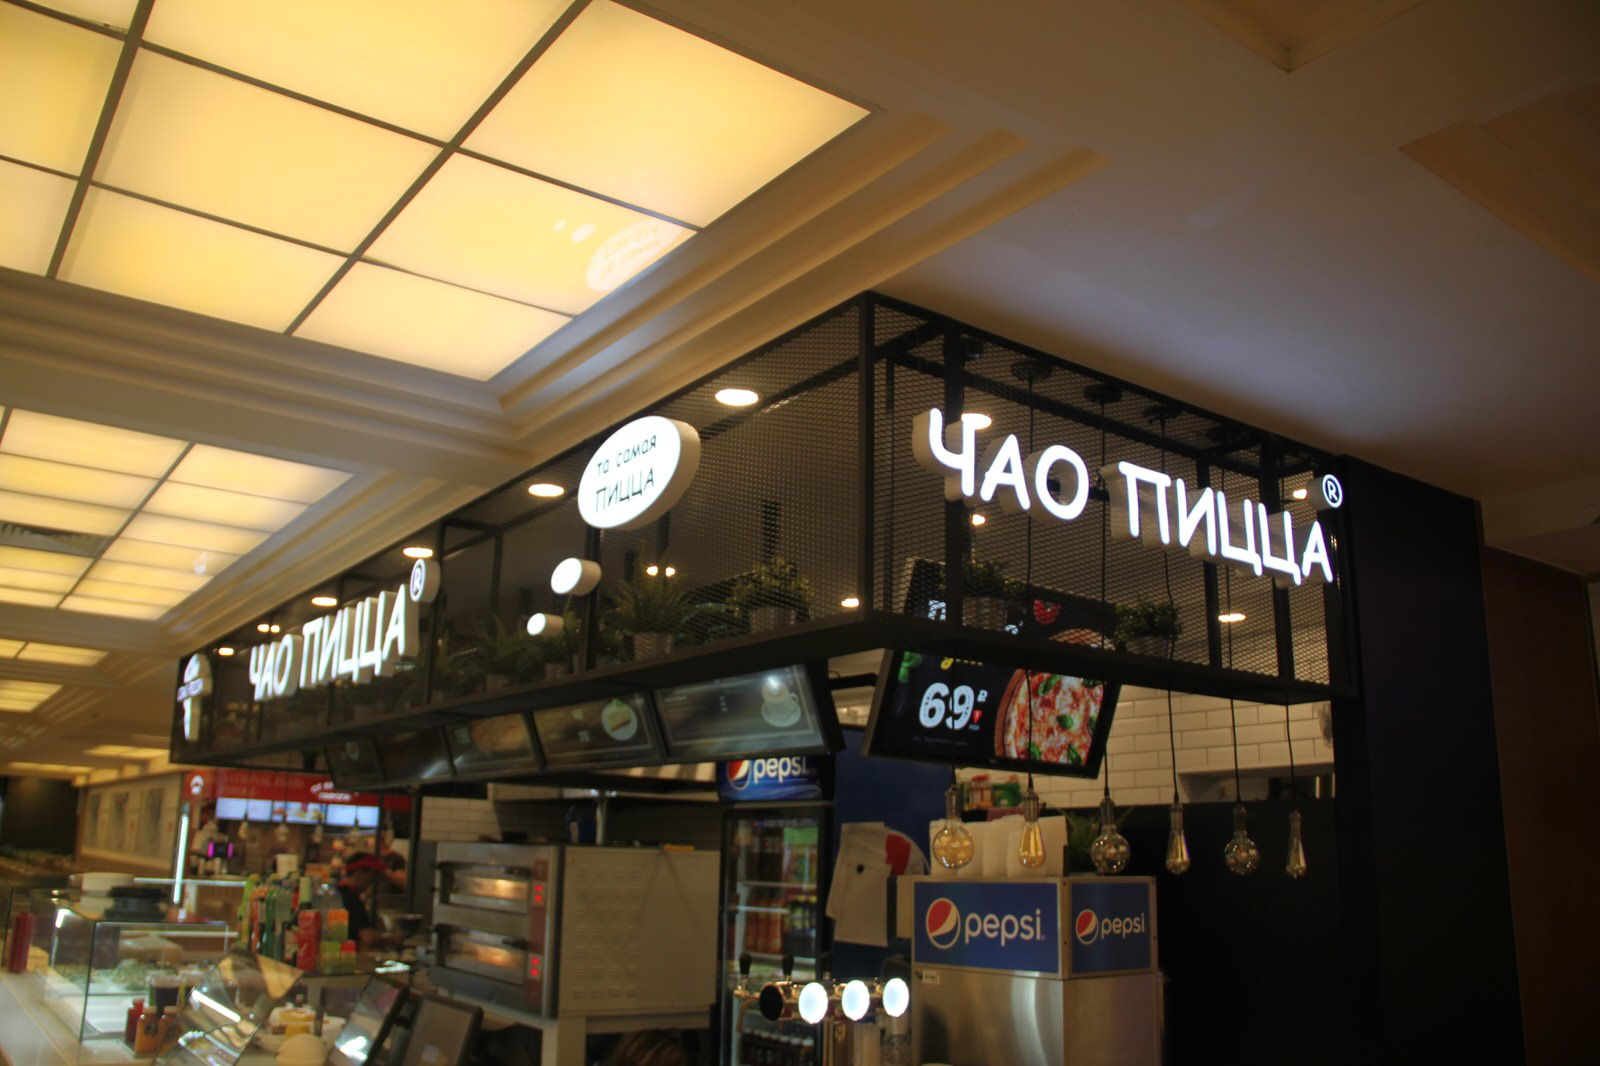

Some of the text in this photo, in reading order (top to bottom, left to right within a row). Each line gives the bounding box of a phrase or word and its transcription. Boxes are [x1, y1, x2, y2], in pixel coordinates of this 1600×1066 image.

[597, 434, 657, 477] та самая
[595, 466, 655, 514] ПИЦЦА
[929, 408, 1333, 586] ЧАО ПИЦЦА
[249, 583, 406, 701] ЧАО ПИЦЦА
[919, 682, 975, 730] 69
[965, 909, 1041, 946] pepsi
[1101, 913, 1145, 939] pepsi
